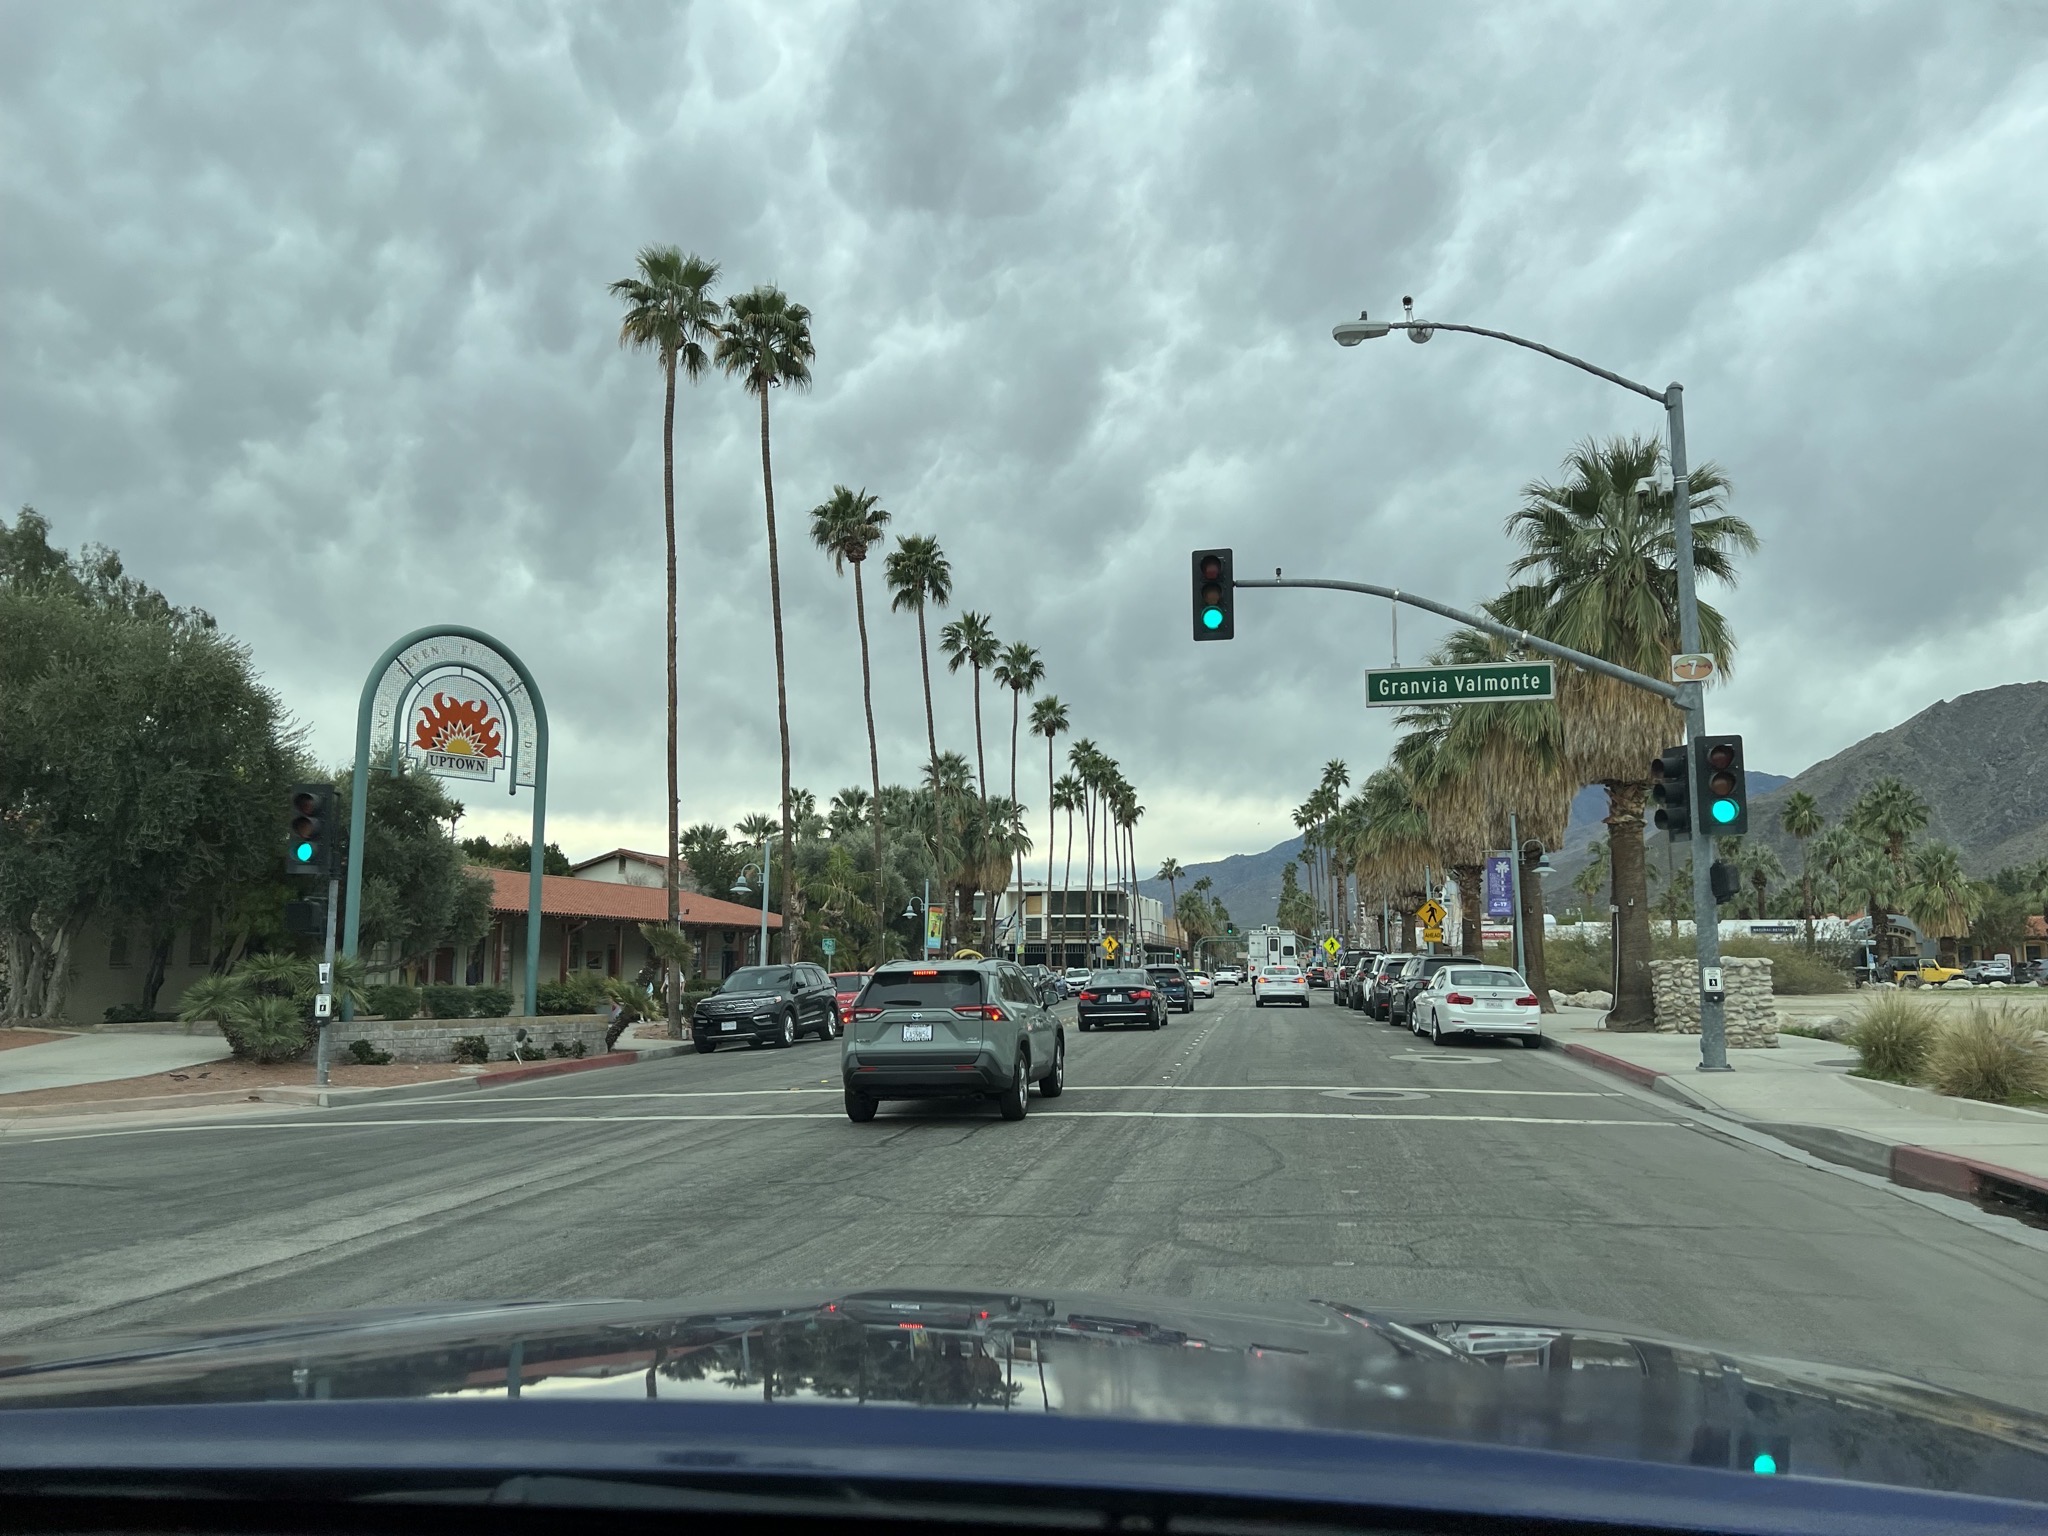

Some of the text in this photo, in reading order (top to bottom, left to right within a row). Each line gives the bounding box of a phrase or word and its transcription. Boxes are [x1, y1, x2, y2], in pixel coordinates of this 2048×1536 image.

[1687, 659, 1697, 676] 7
[1379, 673, 1541, 696] Granvia Valmonte
[429, 754, 486, 772] UPTOWN
